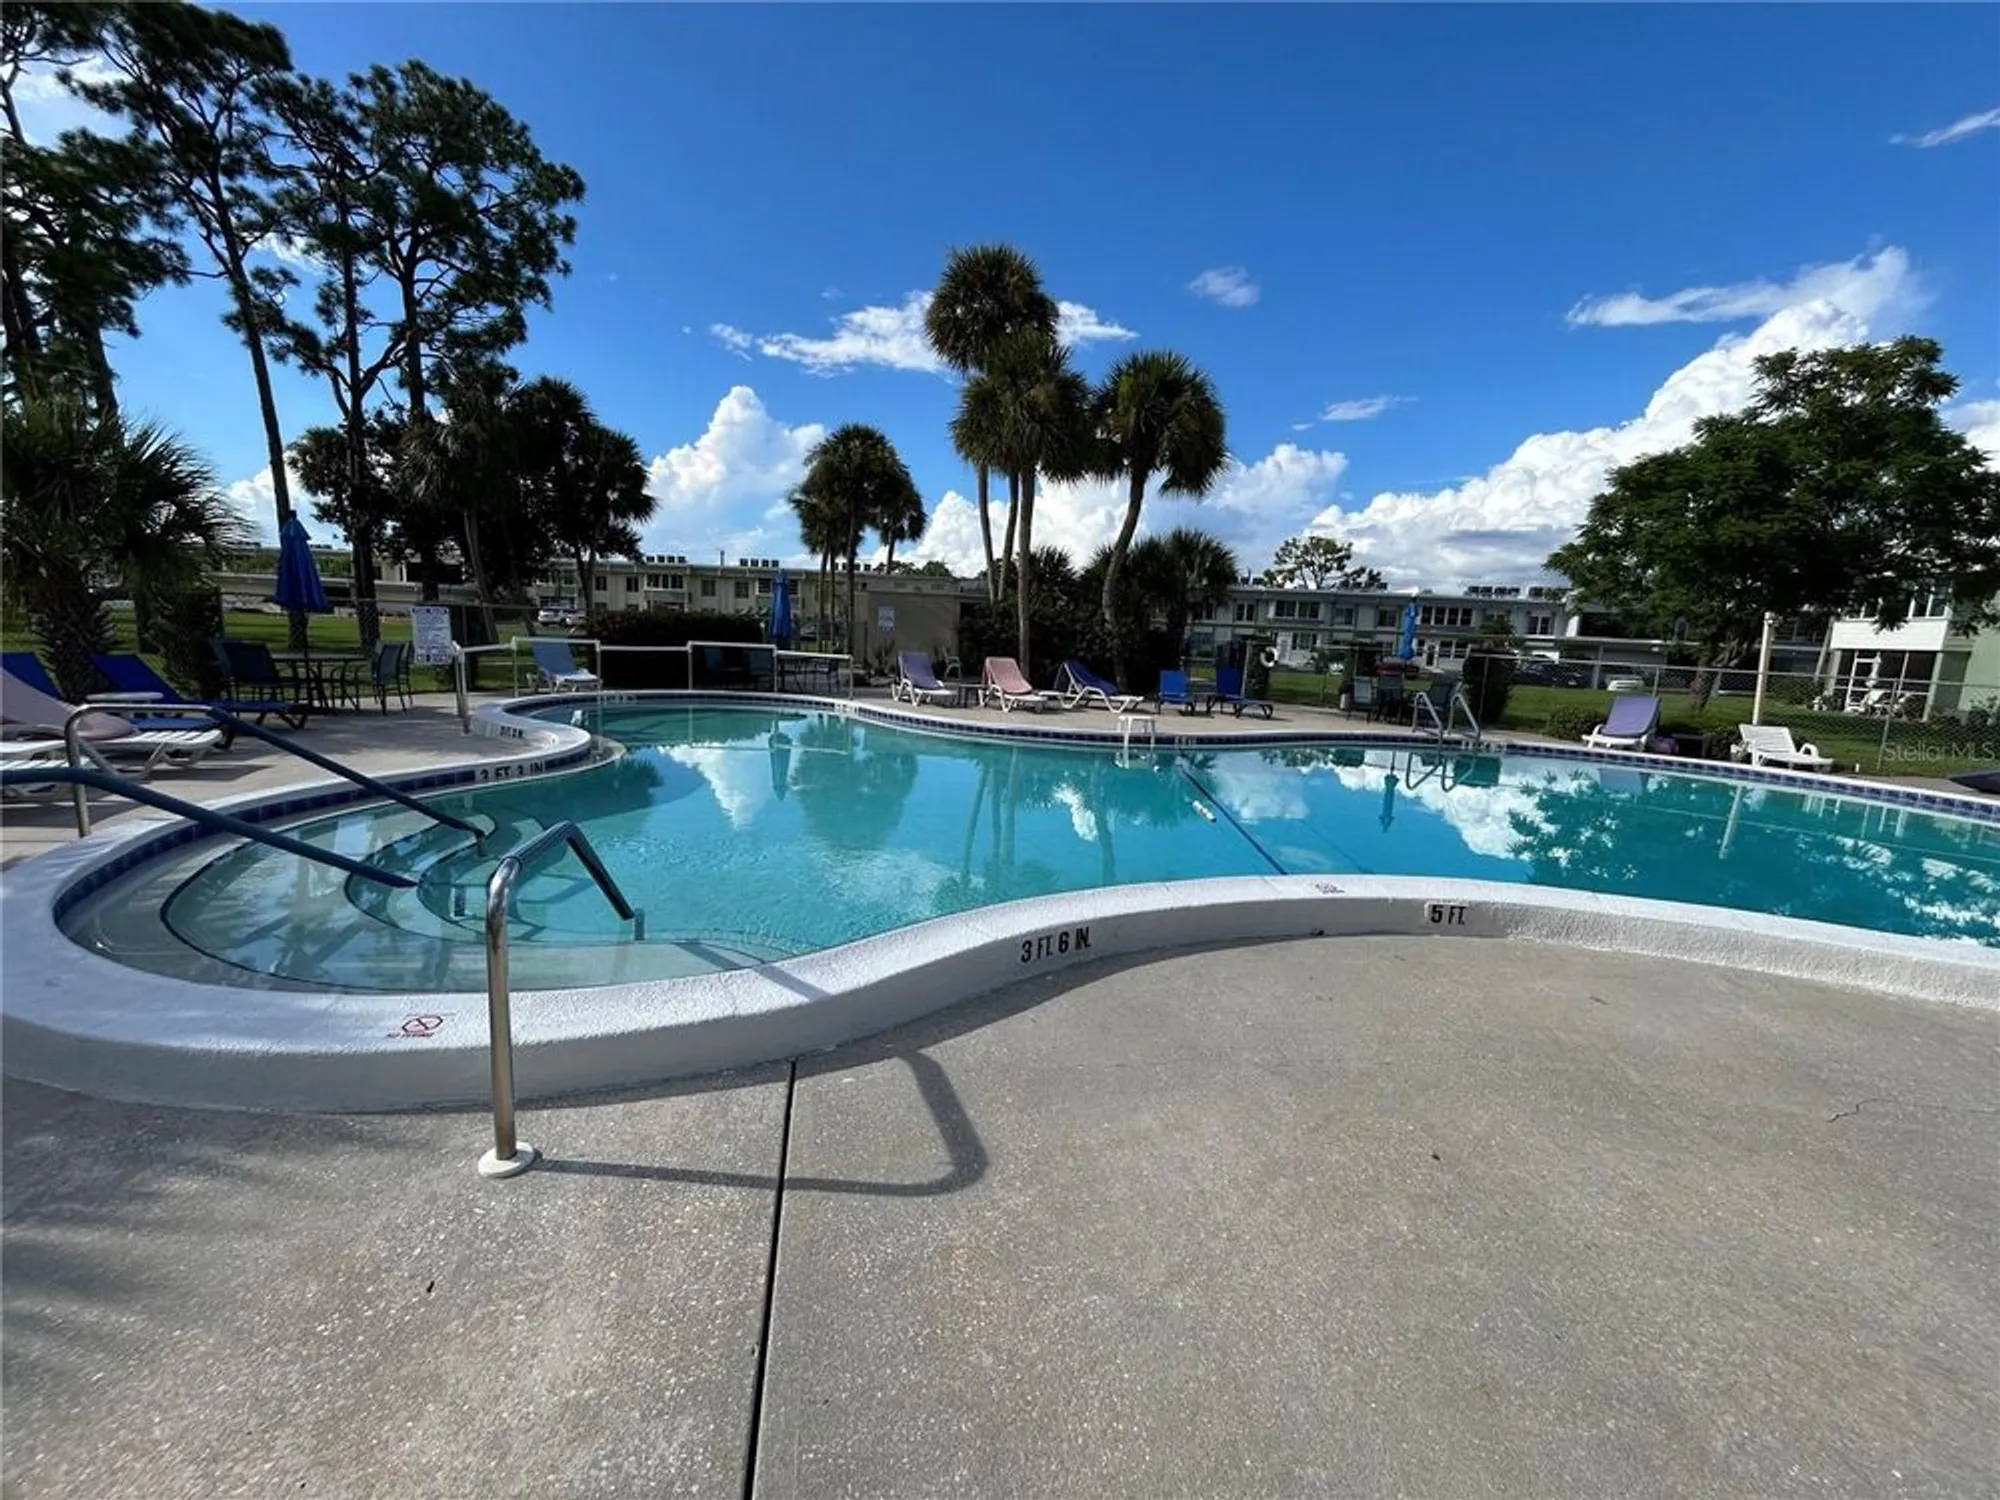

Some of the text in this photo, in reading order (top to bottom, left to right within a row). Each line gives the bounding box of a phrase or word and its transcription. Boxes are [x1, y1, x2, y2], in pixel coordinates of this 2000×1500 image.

[1430, 904, 1443, 923] 5
[1021, 940, 1032, 962] 3
[1058, 931, 1070, 954] 6
